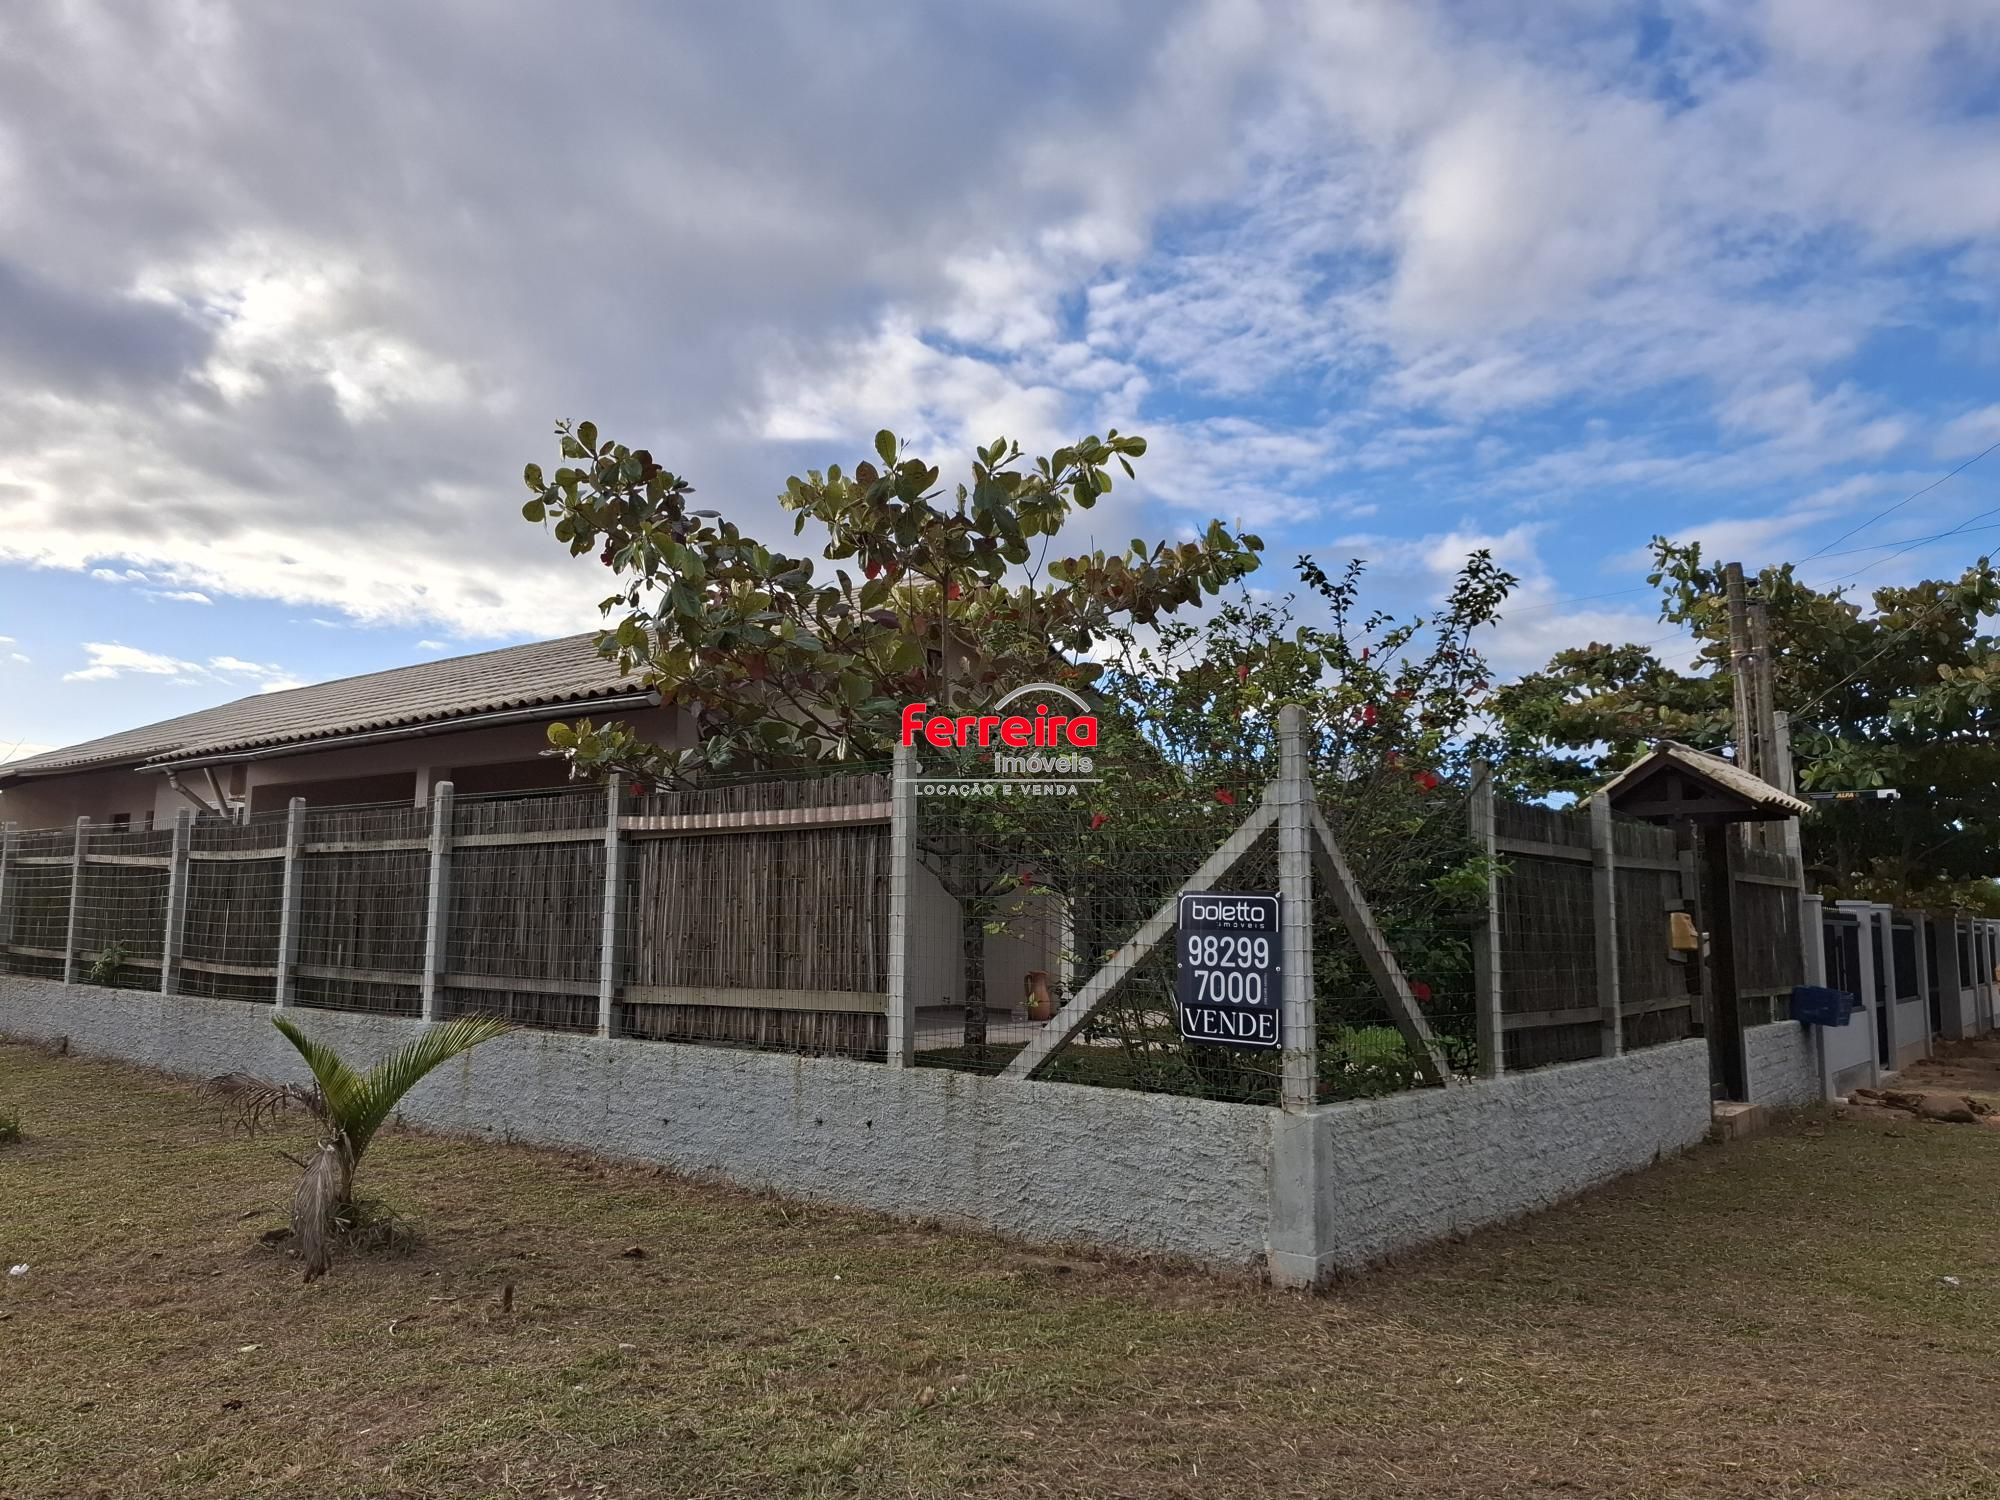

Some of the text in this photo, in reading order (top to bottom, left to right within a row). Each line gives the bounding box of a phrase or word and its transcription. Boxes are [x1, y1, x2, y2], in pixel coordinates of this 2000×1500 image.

[1192, 901, 1265, 922] boletto
[1188, 935, 1269, 969] 98299
[1194, 970, 1262, 1005] 7000
[1185, 1008, 1274, 1039] VENDE
